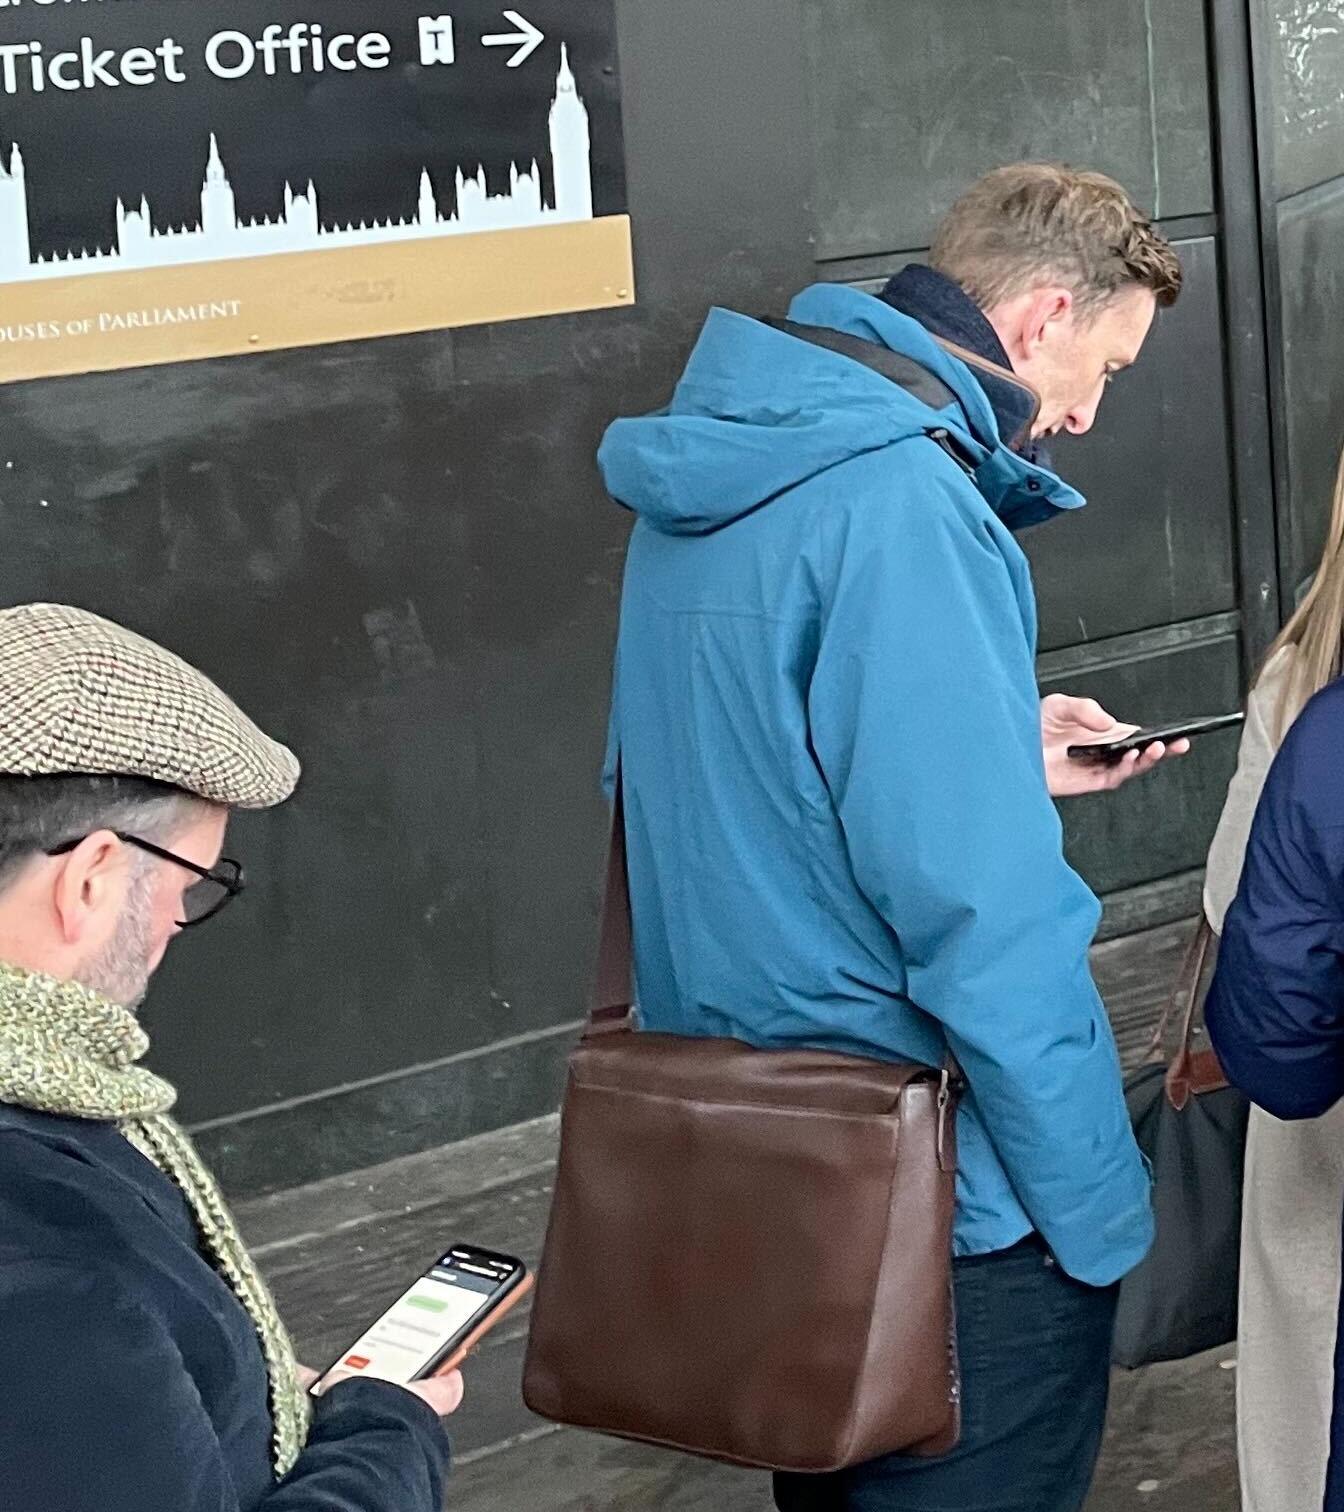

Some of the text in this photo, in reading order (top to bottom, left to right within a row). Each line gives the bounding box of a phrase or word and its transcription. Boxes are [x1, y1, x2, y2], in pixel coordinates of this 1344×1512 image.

[0, 36, 187, 94] Ticket
[204, 24, 392, 79] Office
[66, 319, 94, 336] OF
